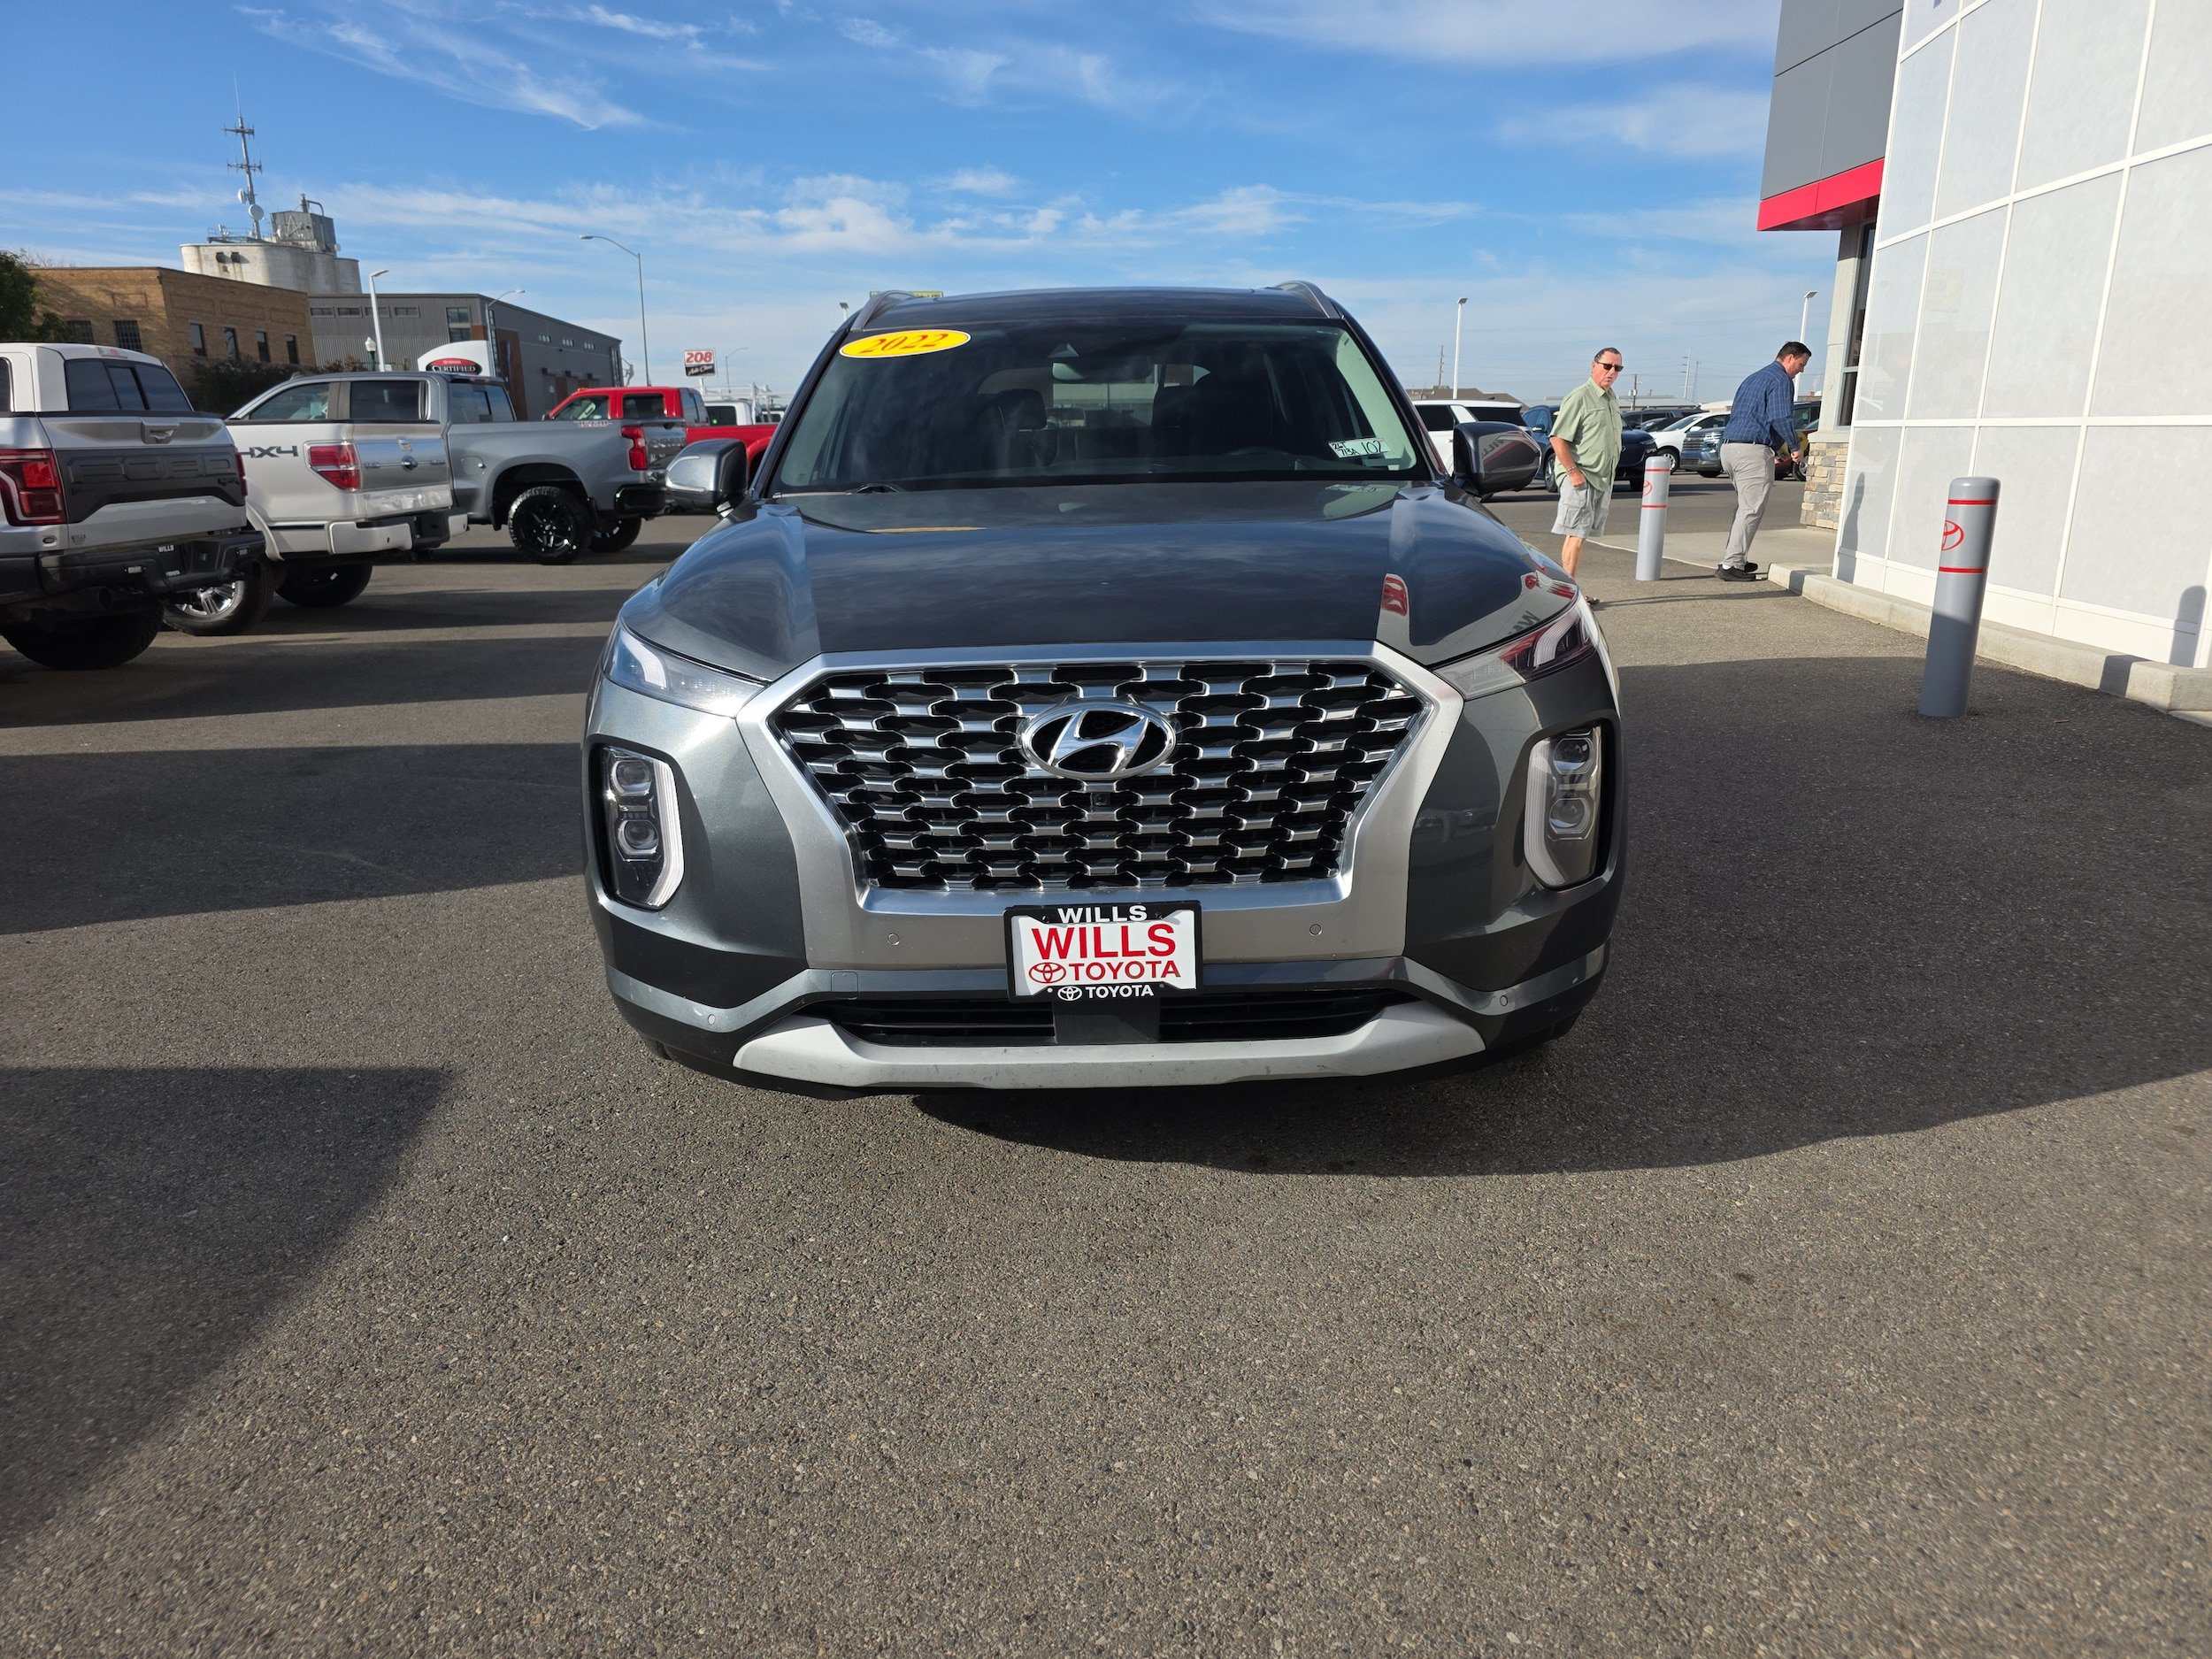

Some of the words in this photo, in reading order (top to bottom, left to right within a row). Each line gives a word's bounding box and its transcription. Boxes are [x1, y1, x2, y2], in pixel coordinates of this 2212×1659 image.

[857, 333, 949, 354] 2022
[686, 351, 713, 364] 208
[1361, 440, 1387, 455] 102
[157, 544, 174, 553] WILLS
[1057, 904, 1148, 924] WILLS
[1031, 923, 1177, 960] WILLS
[1068, 960, 1181, 981] TOYOTA
[1085, 984, 1155, 999] TOYOTA
